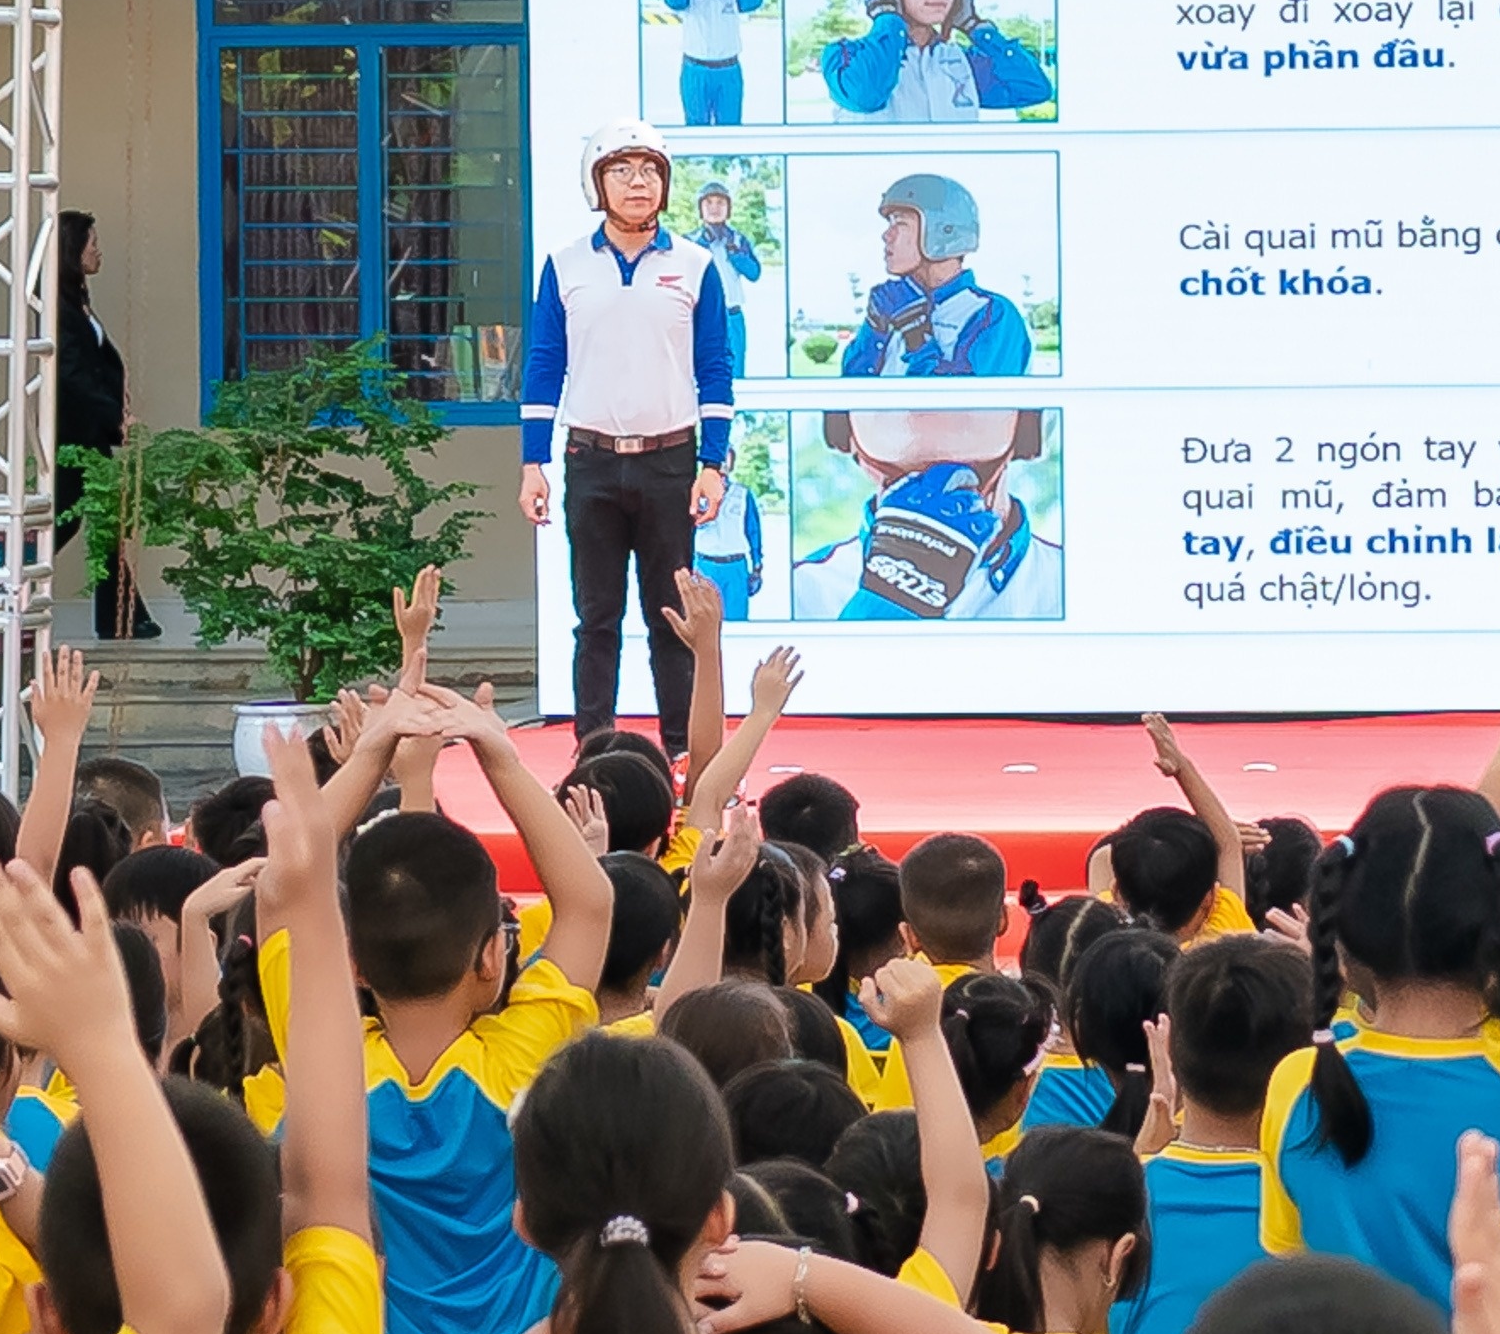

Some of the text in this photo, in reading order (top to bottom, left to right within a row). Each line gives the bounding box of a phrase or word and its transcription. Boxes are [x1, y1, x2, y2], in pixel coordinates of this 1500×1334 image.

[1177, 4, 1255, 32] xoay
[1334, 1, 1413, 29] xoay
[1176, 38, 1455, 78] vừa phần đầu.
[1179, 220, 1230, 250] Cài
[1244, 223, 1316, 257] quai
[1331, 219, 1382, 249] mũ
[1397, 215, 1481, 255] bằng
[1278, 265, 1382, 296] khóa.
[1181, 437, 1251, 464] Đưa
[1276, 436, 1294, 463] 2
[1317, 432, 1401, 470] ngón
[1424, 437, 1477, 469] tay
[1183, 483, 1253, 517] quai
[1281, 479, 1344, 515] mũ,
[1372, 478, 1446, 508] đảm
[1182, 531, 1254, 563] tay,
[1269, 525, 1352, 555] điều
[1366, 524, 1472, 554] chỉnh
[1183, 571, 1245, 610] quá
